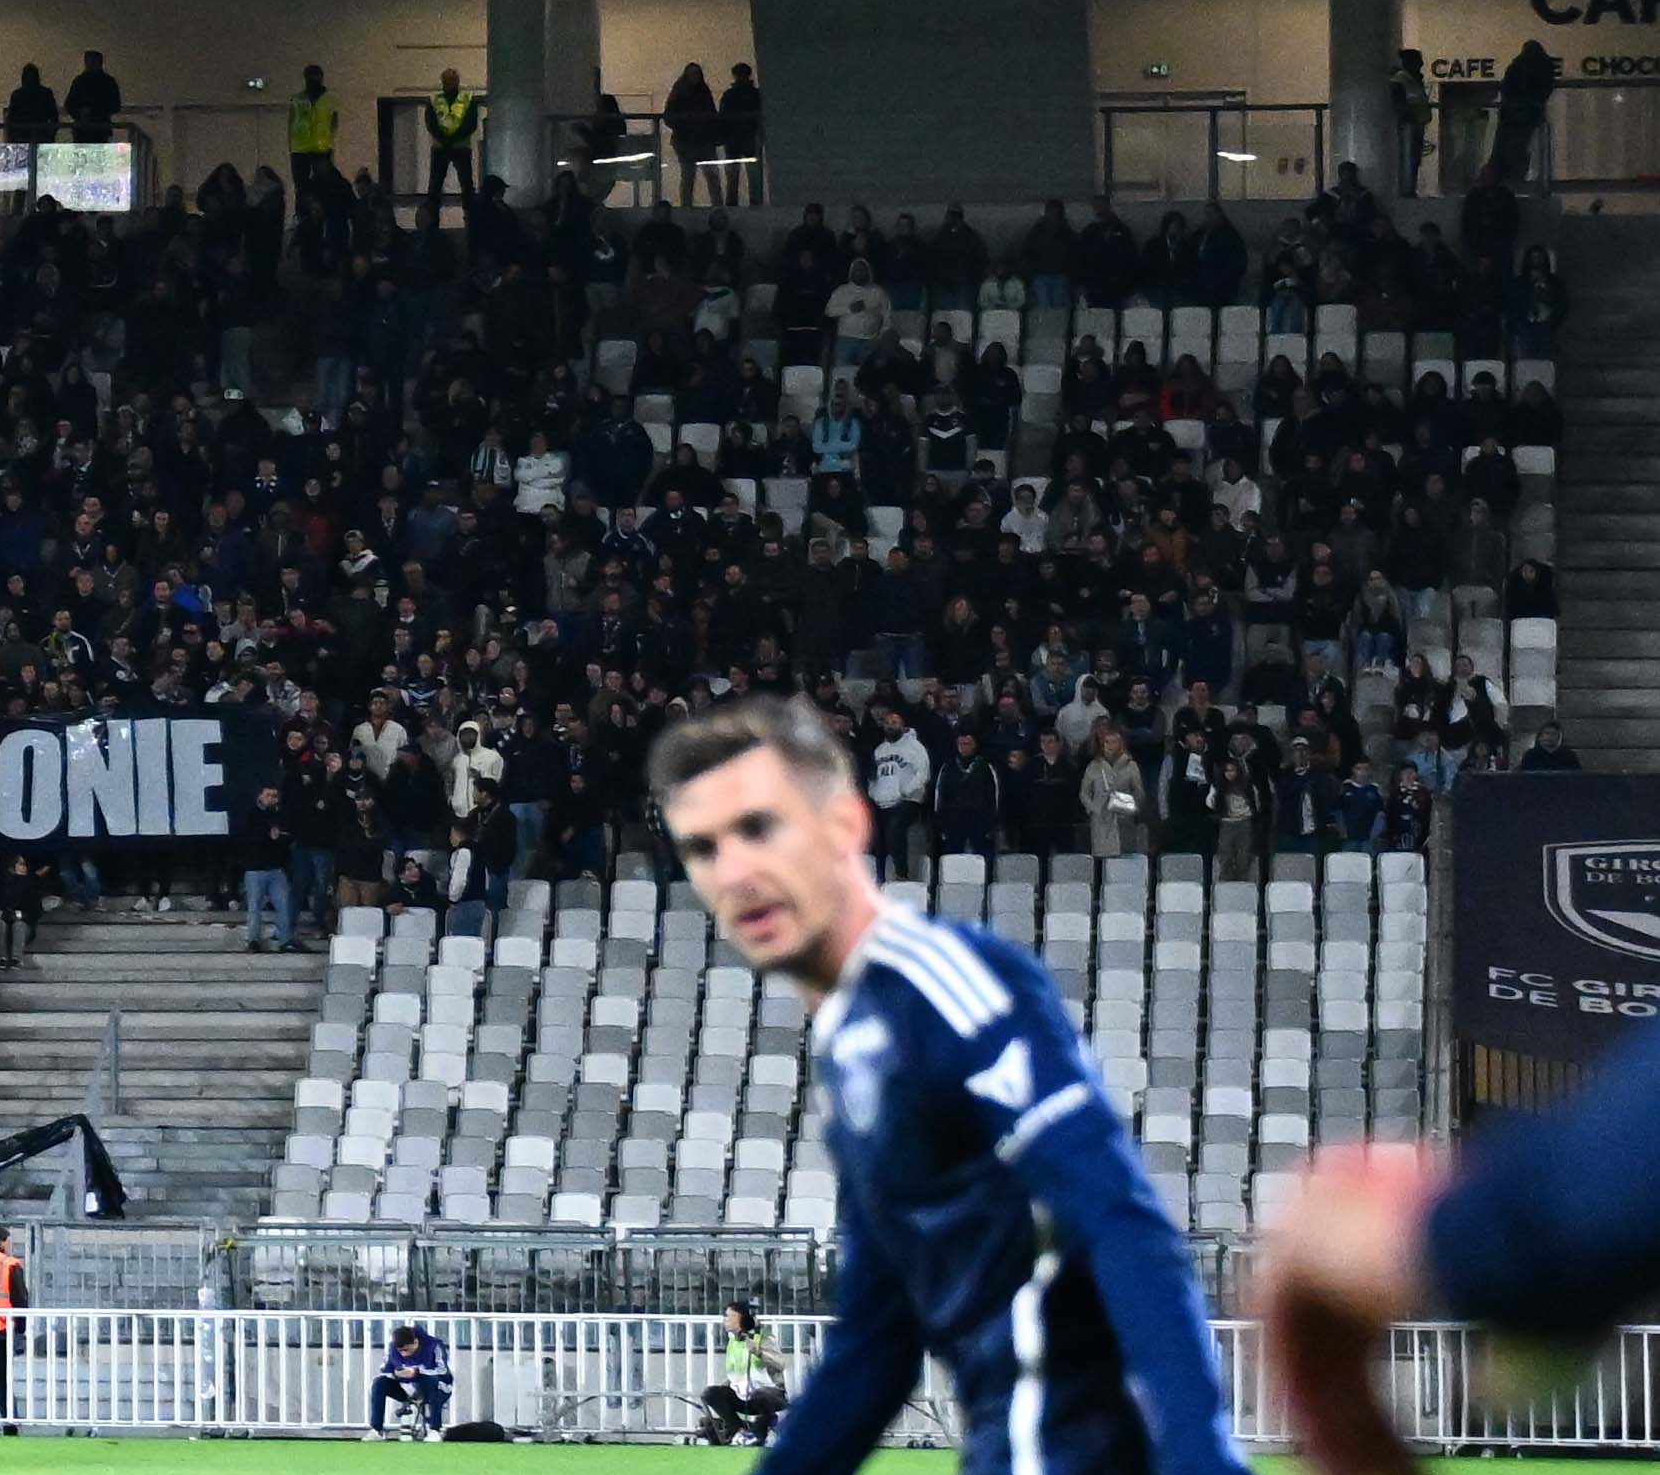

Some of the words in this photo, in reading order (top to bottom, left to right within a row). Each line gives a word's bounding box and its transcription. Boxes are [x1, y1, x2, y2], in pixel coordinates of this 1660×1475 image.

[1430, 58, 1495, 78] CAFE
[1488, 965, 1555, 987] FC
[1488, 983, 1559, 1008] DE
